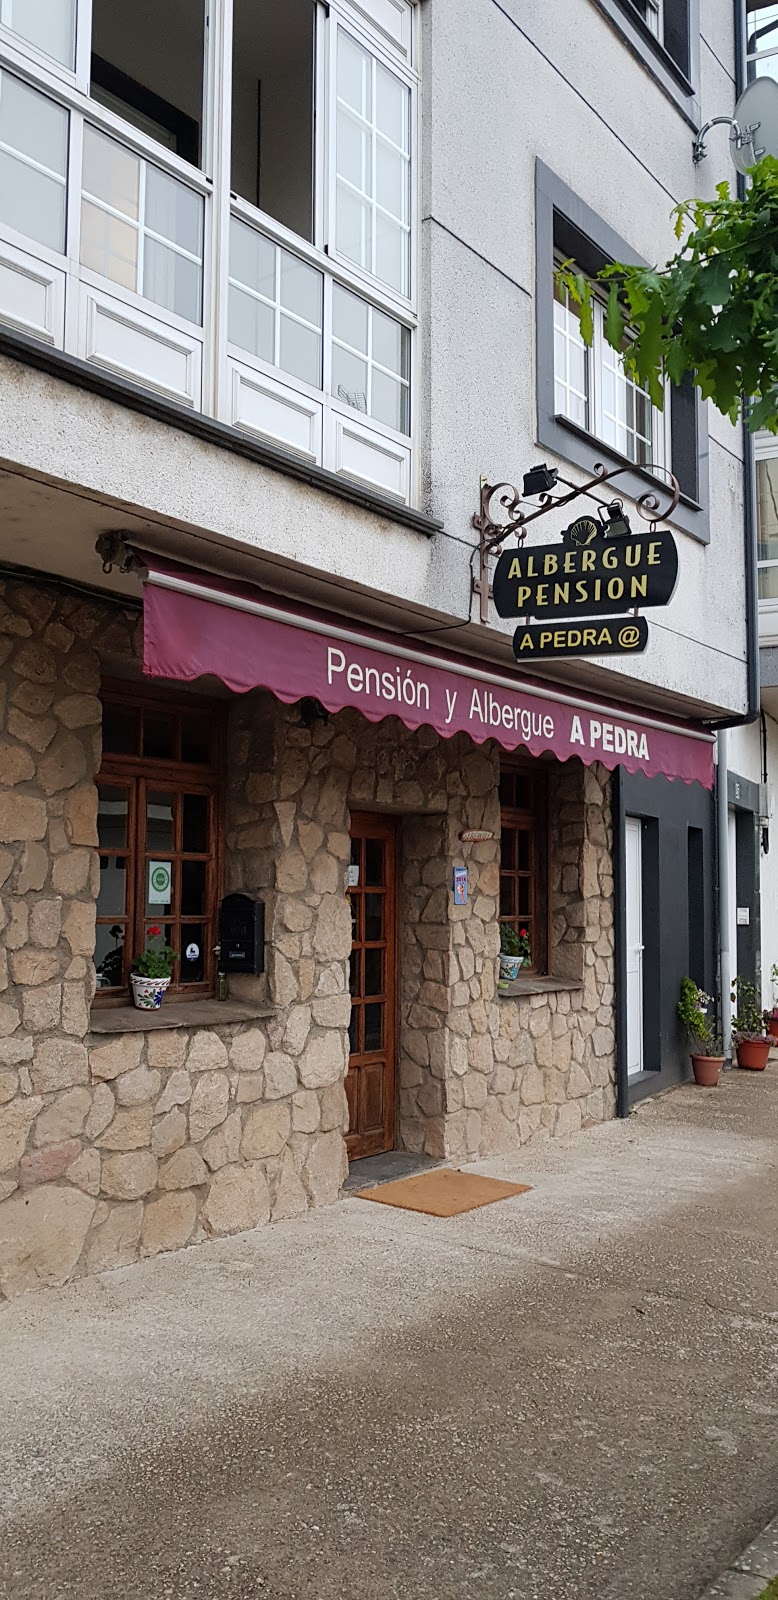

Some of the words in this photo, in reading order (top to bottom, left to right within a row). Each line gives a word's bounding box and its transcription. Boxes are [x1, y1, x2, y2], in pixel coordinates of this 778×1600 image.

[508, 542, 662, 579] ALBERGUE
[517, 575, 648, 608] PENSION
[519, 633, 534, 650] A
[540, 628, 613, 649] PEDRA
[618, 626, 640, 648] @
[326, 647, 430, 710] Pensión
[445, 691, 457, 724] y
[469, 689, 555, 741] Albergue
[569, 716, 585, 746] A
[590, 720, 650, 761] PEDRA
